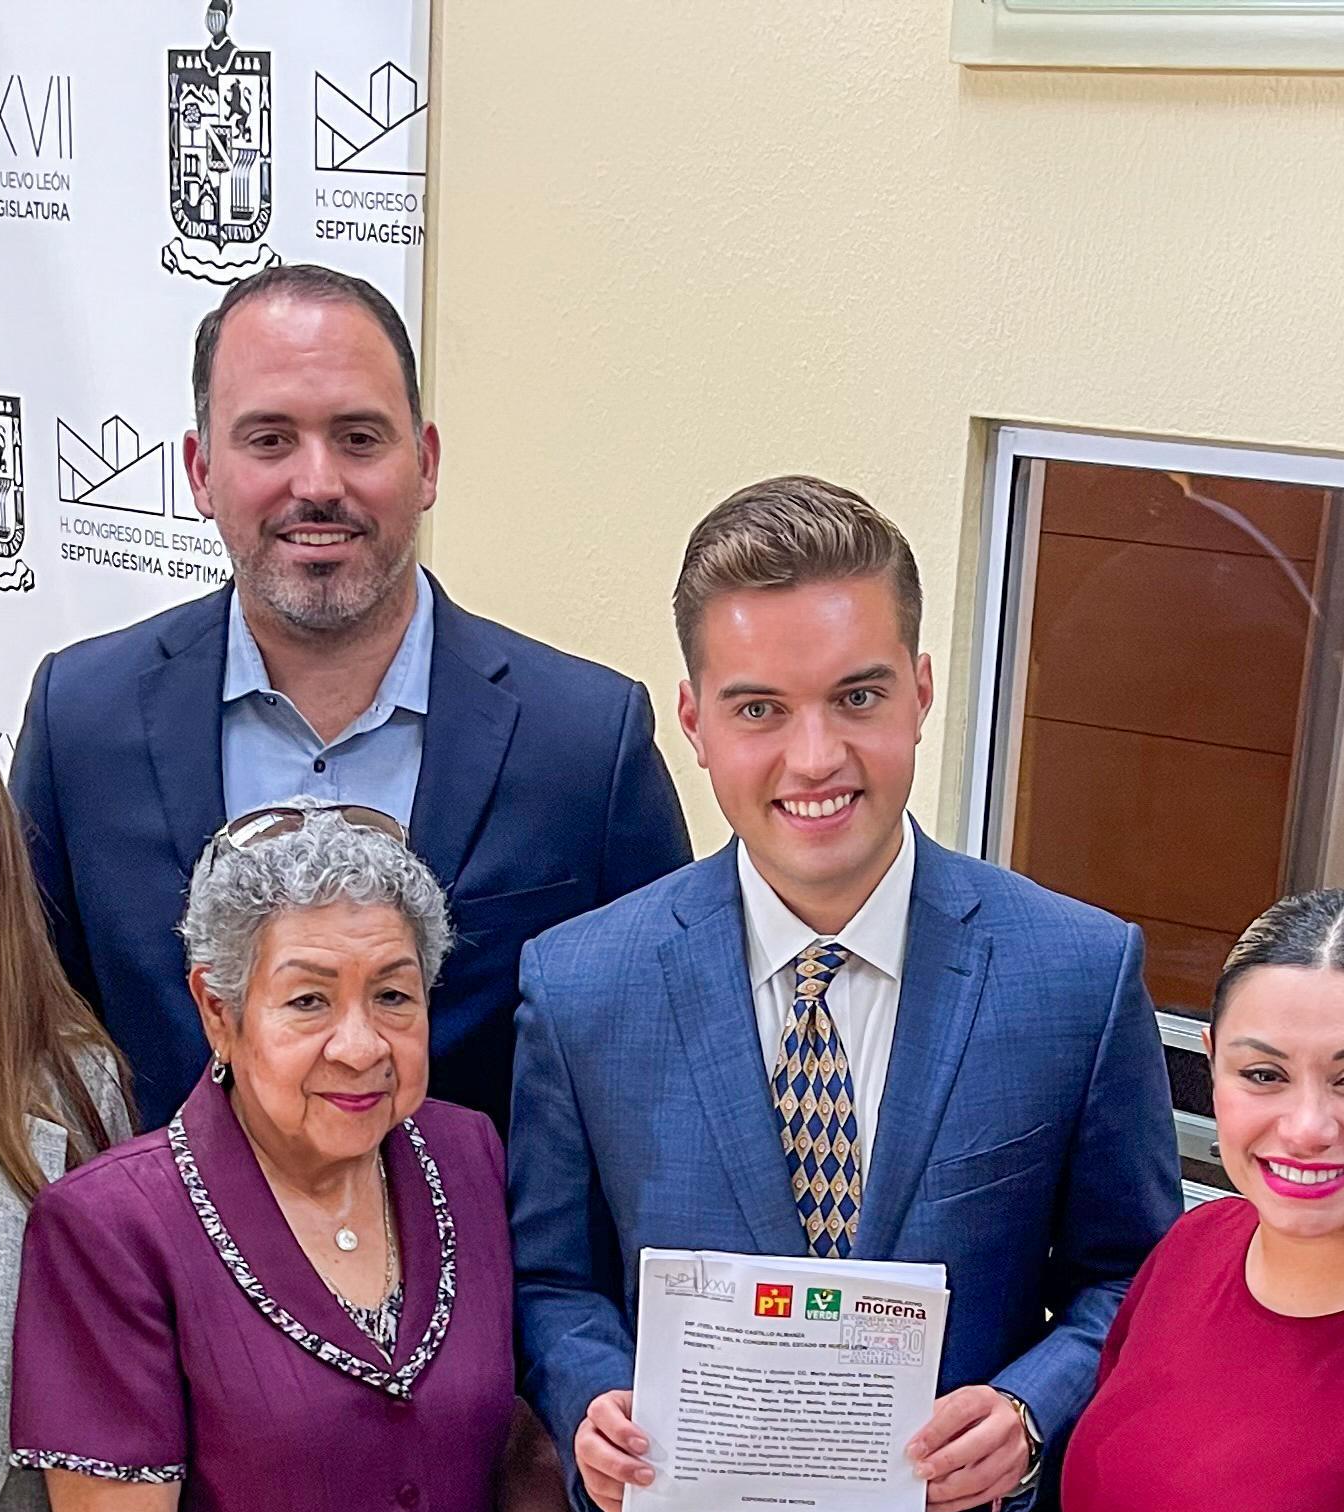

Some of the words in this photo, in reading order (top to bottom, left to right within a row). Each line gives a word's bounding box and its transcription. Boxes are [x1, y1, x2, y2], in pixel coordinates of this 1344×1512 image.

[36, 171, 70, 191] LEÓN
[316, 188, 328, 208] H.
[332, 189, 418, 212] CONGRESO
[74, 519, 142, 544] CONGRESO
[145, 530, 169, 549] DEL
[172, 533, 223, 557] ESTADO
[61, 543, 164, 575] SEPTUAGÉSIMA
[168, 557, 229, 585] SÉPTIMA
[759, 1296, 790, 1316] PT
[806, 1310, 838, 1320] VERDE
[855, 1301, 927, 1320] morena
